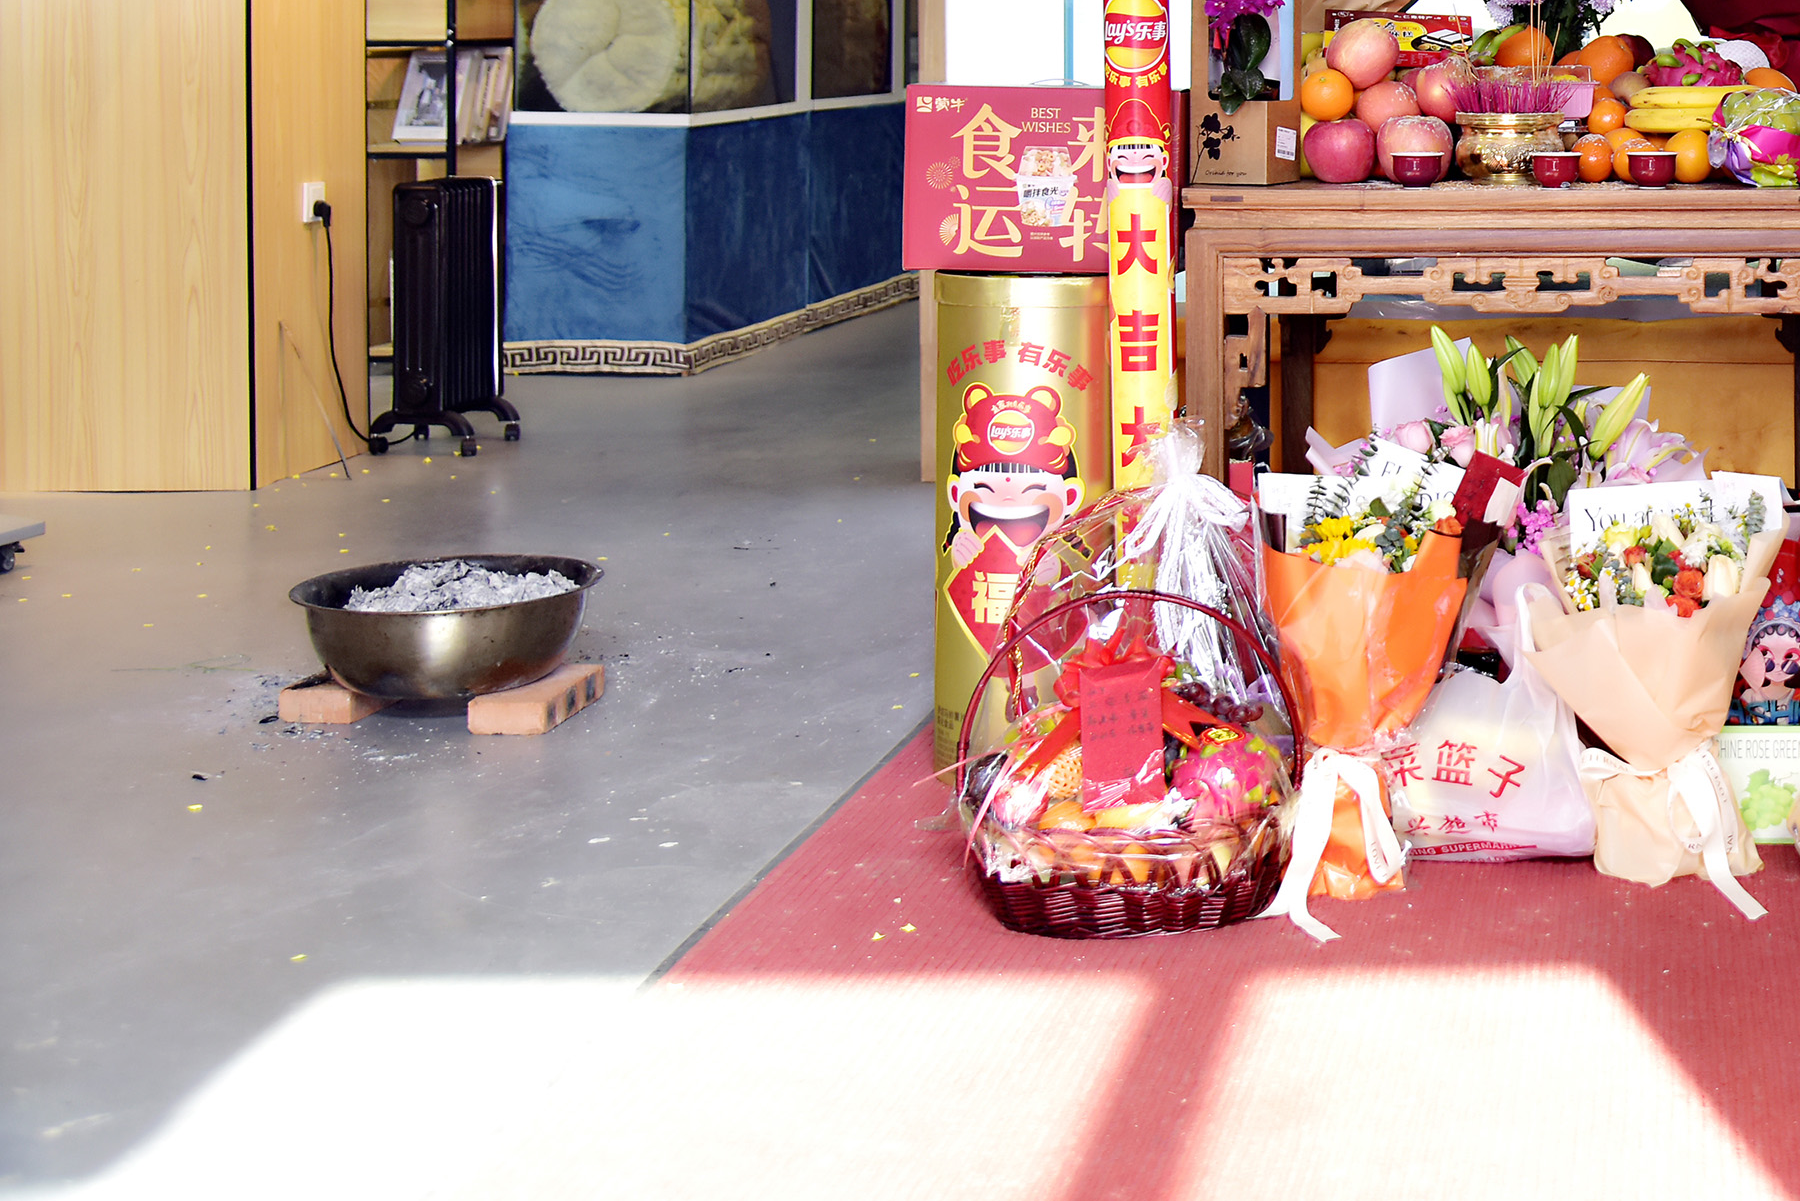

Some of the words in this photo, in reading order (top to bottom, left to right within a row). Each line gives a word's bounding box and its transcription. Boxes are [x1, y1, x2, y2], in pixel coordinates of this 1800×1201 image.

[935, 97, 966, 113] 蒙牛
[1031, 107, 1061, 119] BEST
[1021, 122, 1071, 134] WISHES
[945, 338, 1006, 388] 吃乐事
[1017, 340, 1094, 393] 有乐事
[1117, 213, 1161, 563] 大吉大
[1745, 740, 1769, 759] ROSE
[1381, 739, 1526, 798] 菜篮子
[1441, 841, 1520, 853] SUPERMAR
